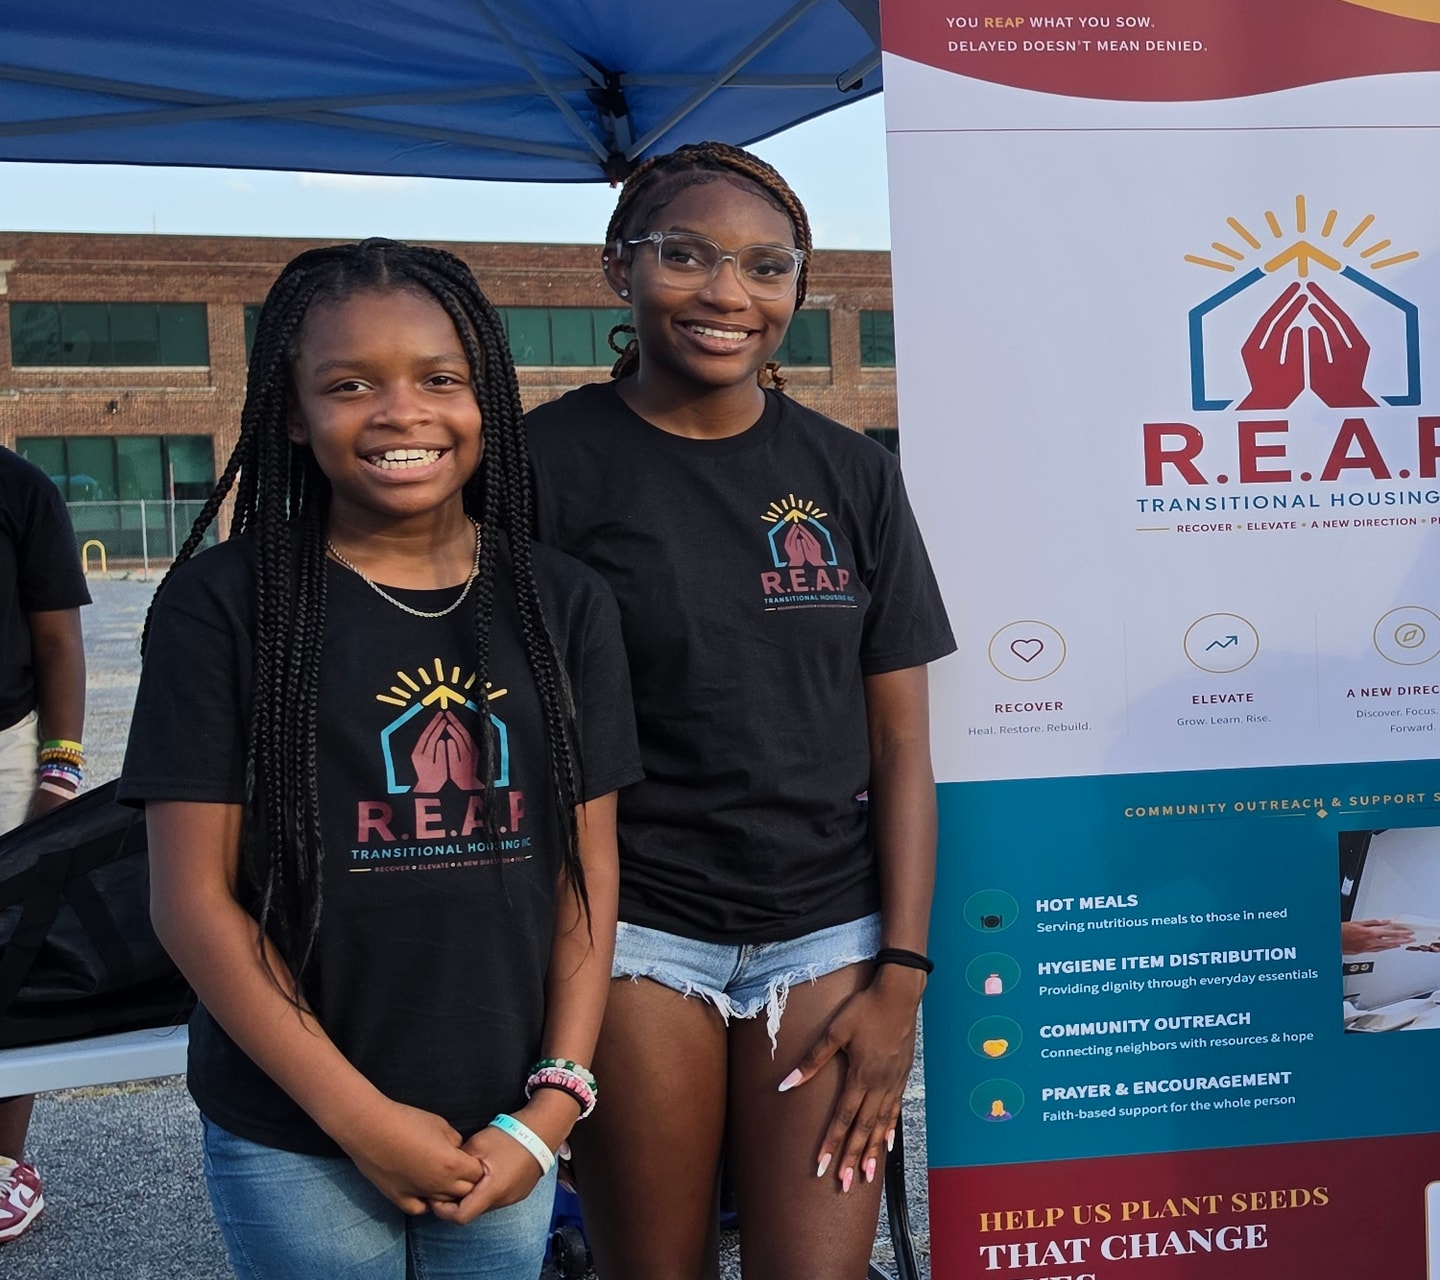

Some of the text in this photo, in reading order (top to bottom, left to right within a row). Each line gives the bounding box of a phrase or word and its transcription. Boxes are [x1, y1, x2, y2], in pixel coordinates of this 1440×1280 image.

[946, 17, 1155, 28] YOU REAP WHAT YOU SOW.
[949, 40, 1207, 51] DELAYED DOESN'T MEAN DENIED.
[1137, 494, 1320, 513] TRANSITIONAL
[1330, 490, 1440, 507] HOUSING
[1177, 524, 1232, 533] RECOVER
[1247, 521, 1297, 531] ELEVATE
[1311, 520, 1319, 529] A
[1322, 520, 1349, 528] NEW
[1354, 517, 1416, 527] DIRECTION
[761, 568, 849, 594] R.E.A.P
[1192, 693, 1254, 705] ELEVATE
[1347, 689, 1355, 698] A
[1361, 687, 1392, 697] NEW
[994, 701, 1063, 713] RECOVER
[1356, 708, 1402, 718] Discover.
[1406, 707, 1439, 716] Focus.
[969, 722, 1092, 736] Heal. Restore. Rebuild.
[1177, 714, 1271, 727] Grow. Learn. Rise.
[1390, 723, 1436, 733] Forward.
[1124, 802, 1228, 818] COMMUNITY
[1233, 798, 1325, 814] OUTREACH
[1332, 797, 1342, 807] &
[1350, 793, 1425, 806] SUPPORT
[351, 845, 463, 860] TRANSITIONAL
[1036, 894, 1138, 913] HOT MEALS
[1037, 907, 1288, 933] Serving nutritious meals to those in need
[1038, 947, 1296, 975] HYGIENE ITEM DISTRIBUTION
[1039, 968, 1318, 996] Providing dignity through everyday essentials
[1040, 1012, 1251, 1038] COMMUNITY OUTREACH
[1041, 1031, 1314, 1059] Connecting neighbors with resources & hope
[1042, 1072, 1292, 1101] PRAYER & ENCOURAGEMENT
[1043, 1095, 1296, 1122] Faith-based support for the whole person
[979, 1186, 1330, 1232] HELP US PLANT SEEDS
[980, 1224, 1268, 1270] THAT CHANGE
